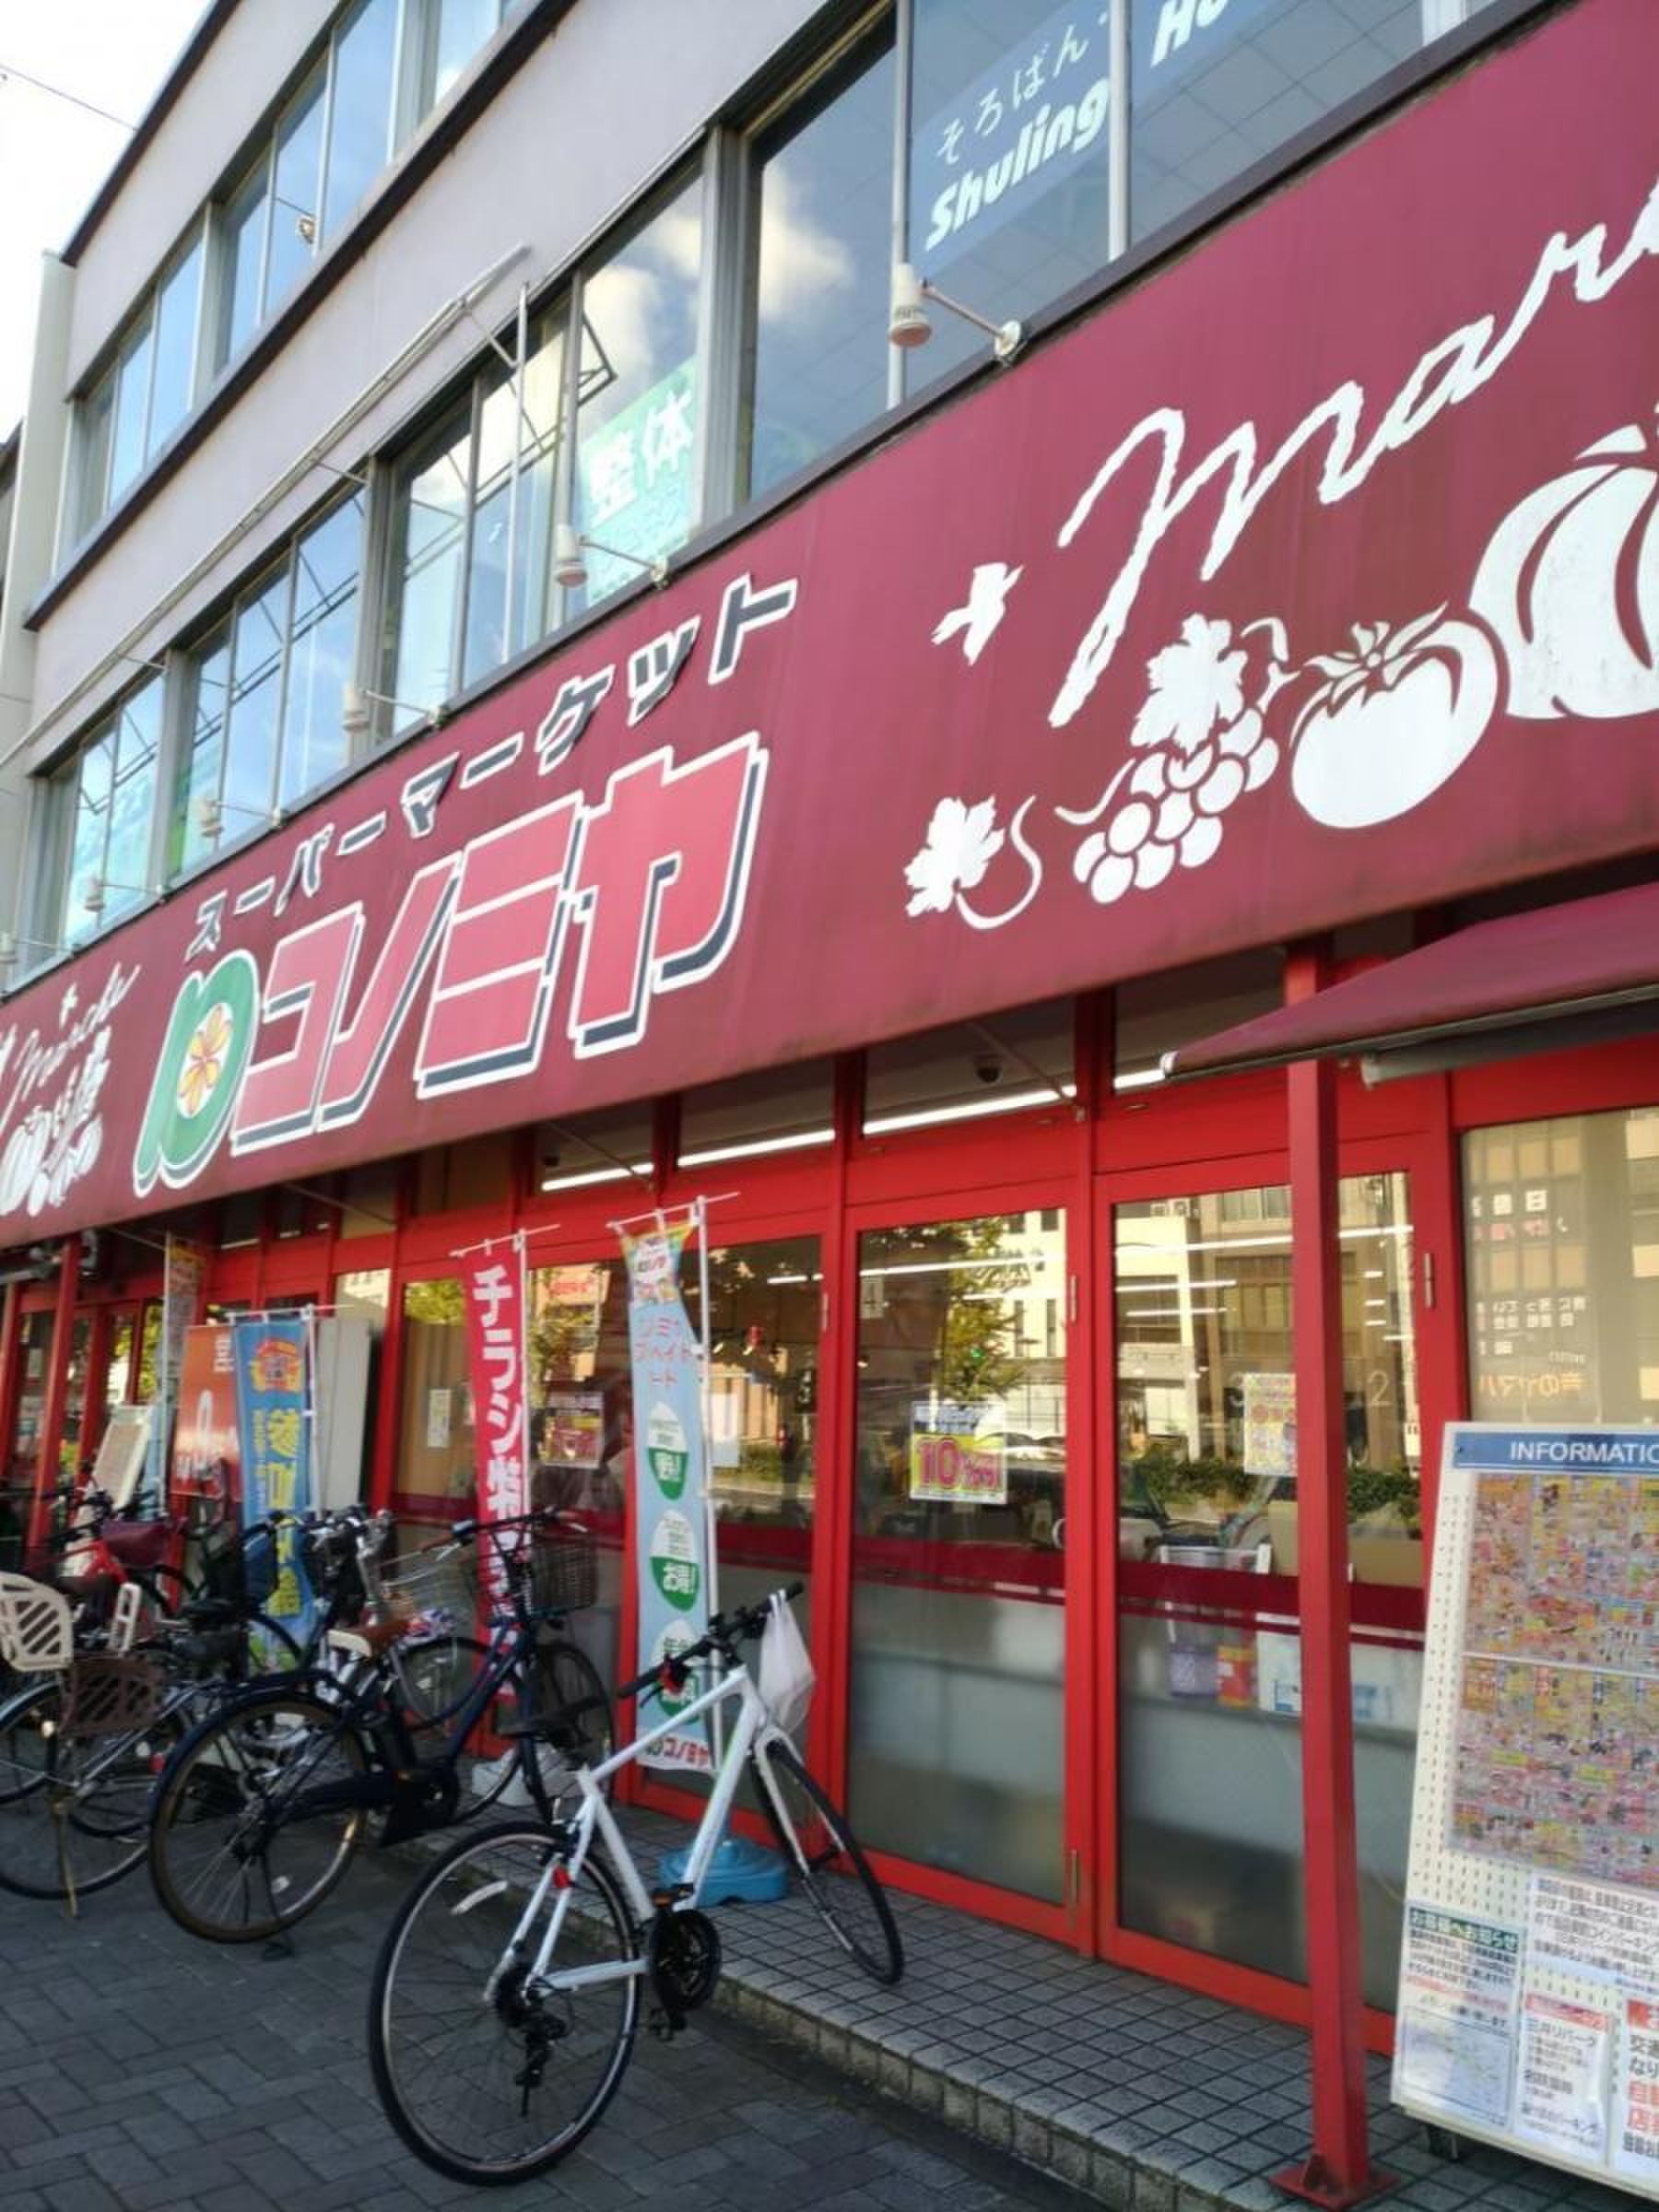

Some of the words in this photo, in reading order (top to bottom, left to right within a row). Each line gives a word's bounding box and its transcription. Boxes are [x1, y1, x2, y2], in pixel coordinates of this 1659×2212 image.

[924, 76, 1110, 252] Shuling
[935, 10, 1109, 166] そろばん
[184, 572, 799, 963] スーパーマーケット
[229, 730, 770, 1158] コノミヤ
